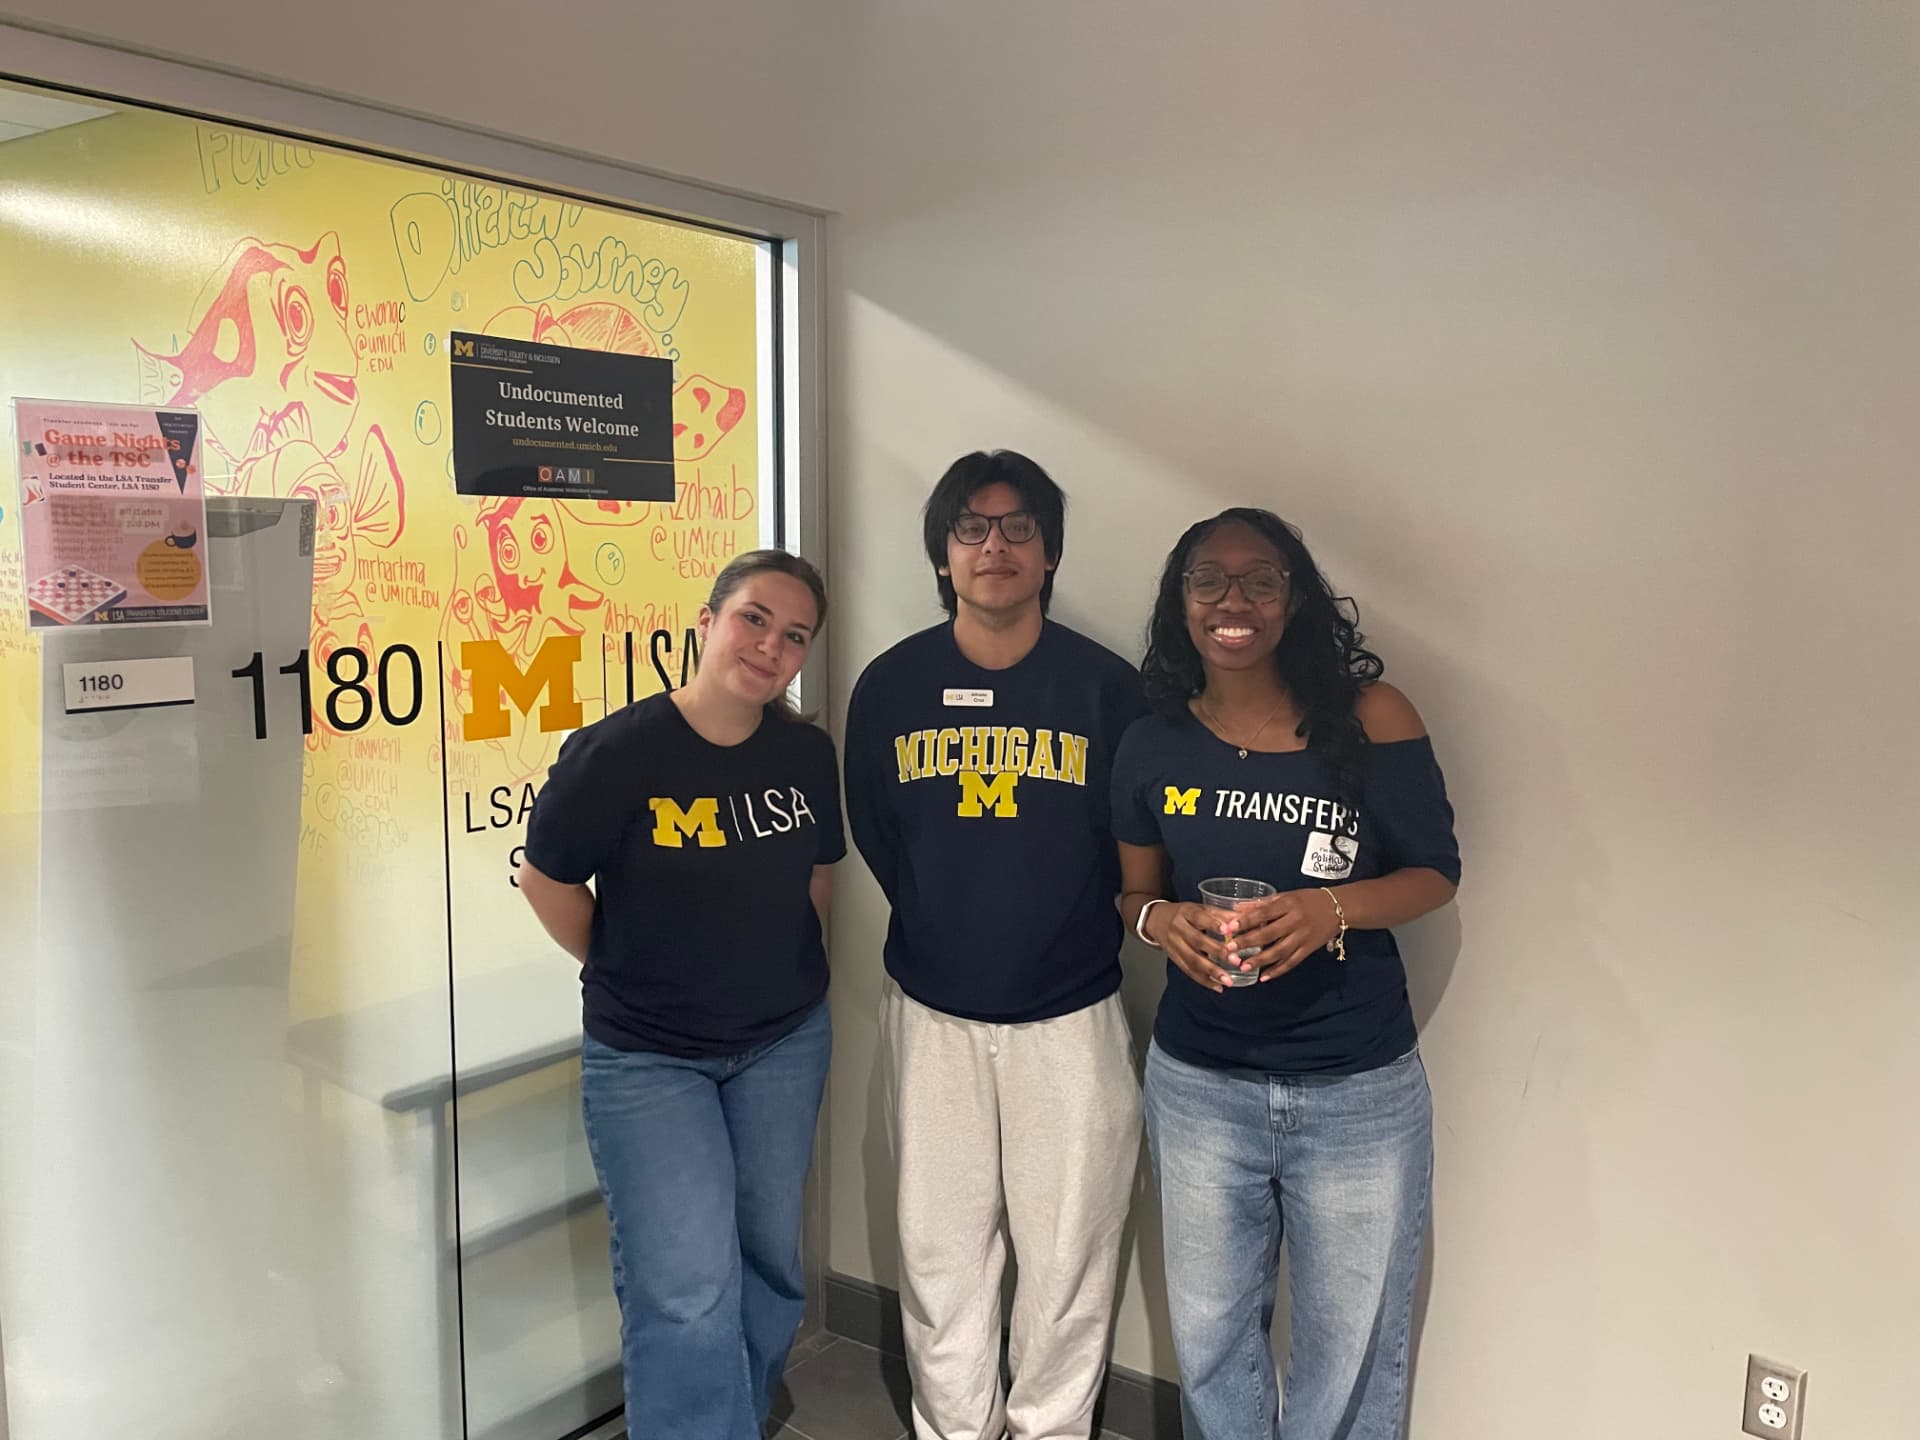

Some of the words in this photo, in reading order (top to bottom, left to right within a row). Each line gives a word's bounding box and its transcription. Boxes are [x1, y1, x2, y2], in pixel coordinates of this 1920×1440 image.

[513, 236, 690, 334] Journey
[454, 339, 474, 357] M
[499, 381, 624, 410] Undocumented
[485, 408, 561, 431] Students
[565, 416, 639, 437] Welcome
[44, 429, 107, 447] Game
[113, 432, 180, 452] Nights
[512, 437, 618, 453] undocumented.umich.edu
[47, 454, 61, 468] @
[68, 450, 103, 466] the
[110, 451, 151, 468] TSC
[49, 472, 84, 481] Located
[87, 473, 96, 481] in
[98, 473, 114, 482] the
[115, 474, 133, 482] LSA
[135, 475, 172, 484] Transfer
[121, 483, 138, 491] LSA
[660, 464, 754, 521] zohaib
[80, 674, 124, 692] 1180
[232, 643, 422, 739] 1180
[461, 635, 583, 741] M
[895, 727, 1089, 786] MICHIGAN
[465, 782, 538, 833] LSA
[958, 770, 1019, 817] M
[1164, 786, 1201, 816] M
[649, 797, 727, 849] M
[744, 786, 816, 839] LSA
